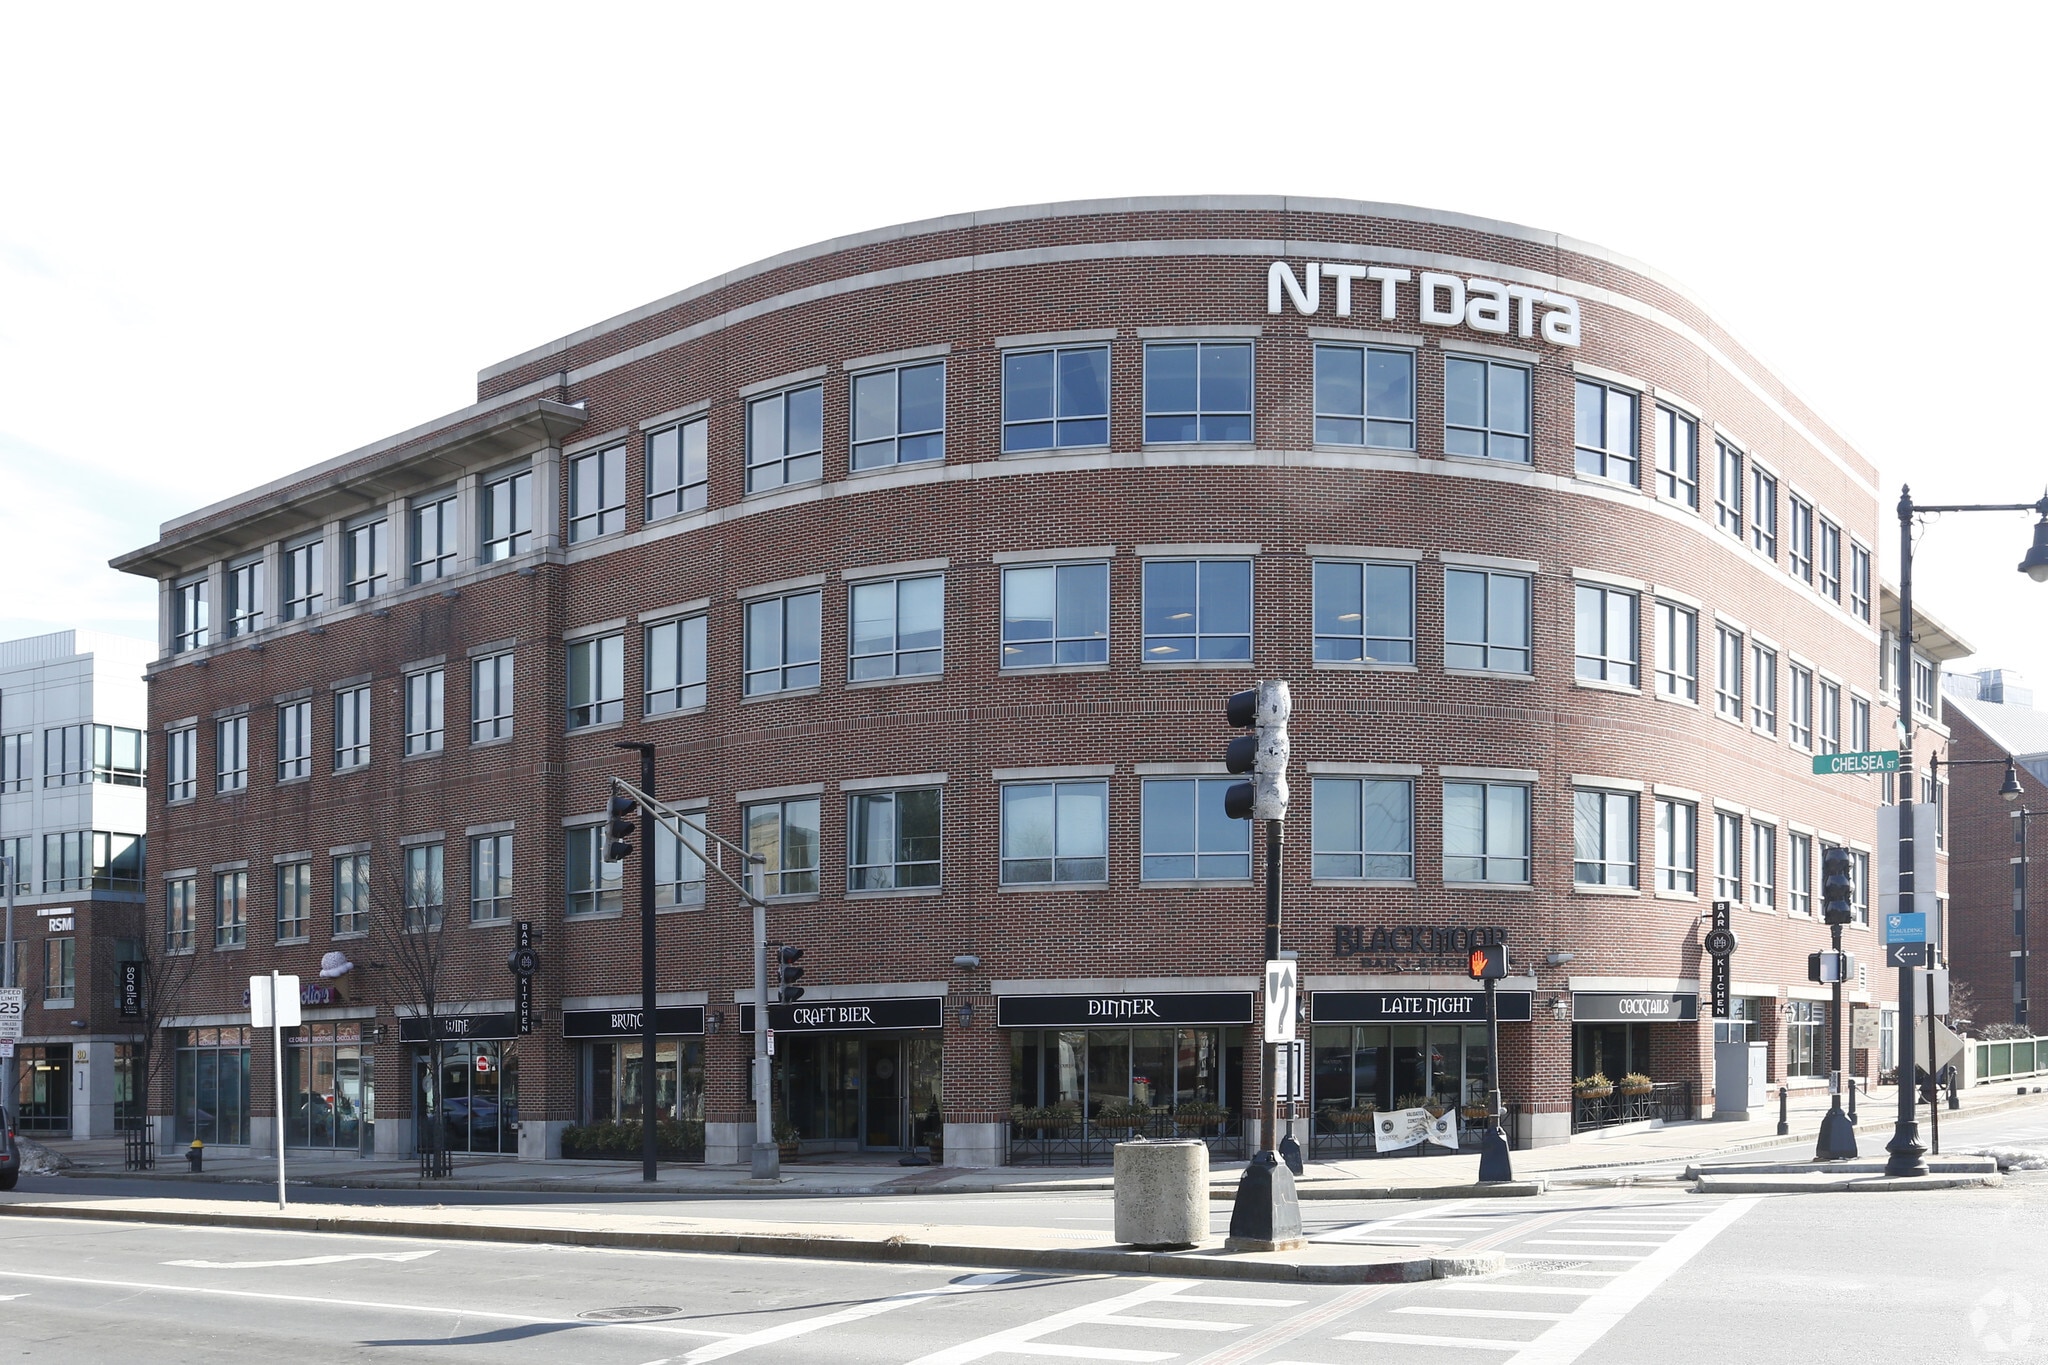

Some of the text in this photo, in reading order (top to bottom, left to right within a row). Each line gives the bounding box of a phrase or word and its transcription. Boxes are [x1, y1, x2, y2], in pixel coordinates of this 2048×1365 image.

[1268, 261, 1411, 321] NTT
[1831, 755, 1895, 772] CHELSEA ST
[1717, 903, 1725, 926] BAR
[49, 917, 74, 932] RSM
[1361, 957, 1397, 968] BAR
[126, 966, 137, 1005] sorelle
[1716, 958, 1725, 1015] KITCHEN
[0, 1002, 20, 1014] 25
[1088, 999, 1161, 1018] DINNER
[1381, 996, 1473, 1016] LATE NIGHT
[1619, 998, 1669, 1016] COCKTAILS
[611, 1012, 644, 1030] BRUNC
[793, 1006, 876, 1026] CRAFT BIER
[445, 1019, 470, 1035] WINE
[76, 1049, 87, 1060] 80
